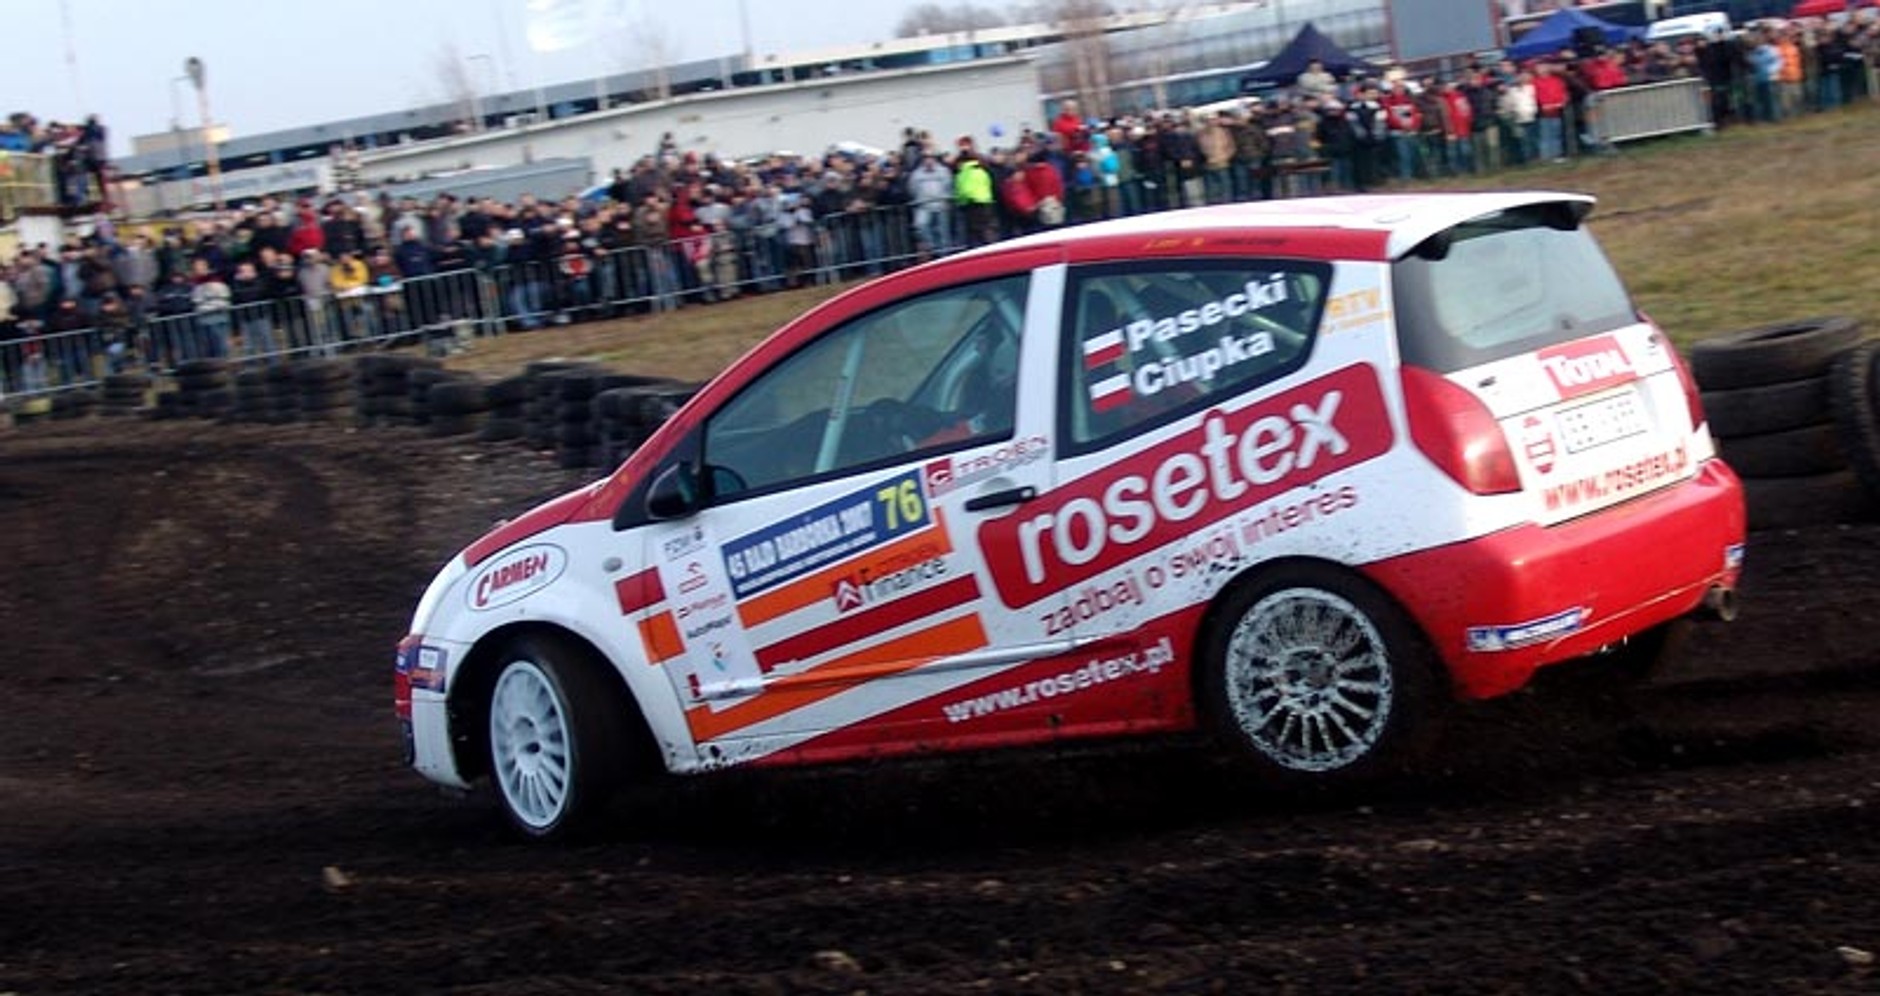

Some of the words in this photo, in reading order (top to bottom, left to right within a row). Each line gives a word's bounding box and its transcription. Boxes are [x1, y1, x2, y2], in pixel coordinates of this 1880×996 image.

[1126, 273, 1288, 351] Pasecki
[1133, 331, 1275, 396] Ciupka
[877, 479, 923, 530] 76
[1017, 390, 1349, 585] rosetex
[475, 552, 548, 607] CARMEN
[728, 551, 745, 580] 45
[744, 540, 778, 575] RAJD
[855, 557, 947, 602] Finance
[1039, 568, 1144, 637] zadbaj
[1146, 565, 1165, 590] o
[1240, 484, 1357, 546] interes
[943, 637, 1175, 724] www.rosetex.pl
